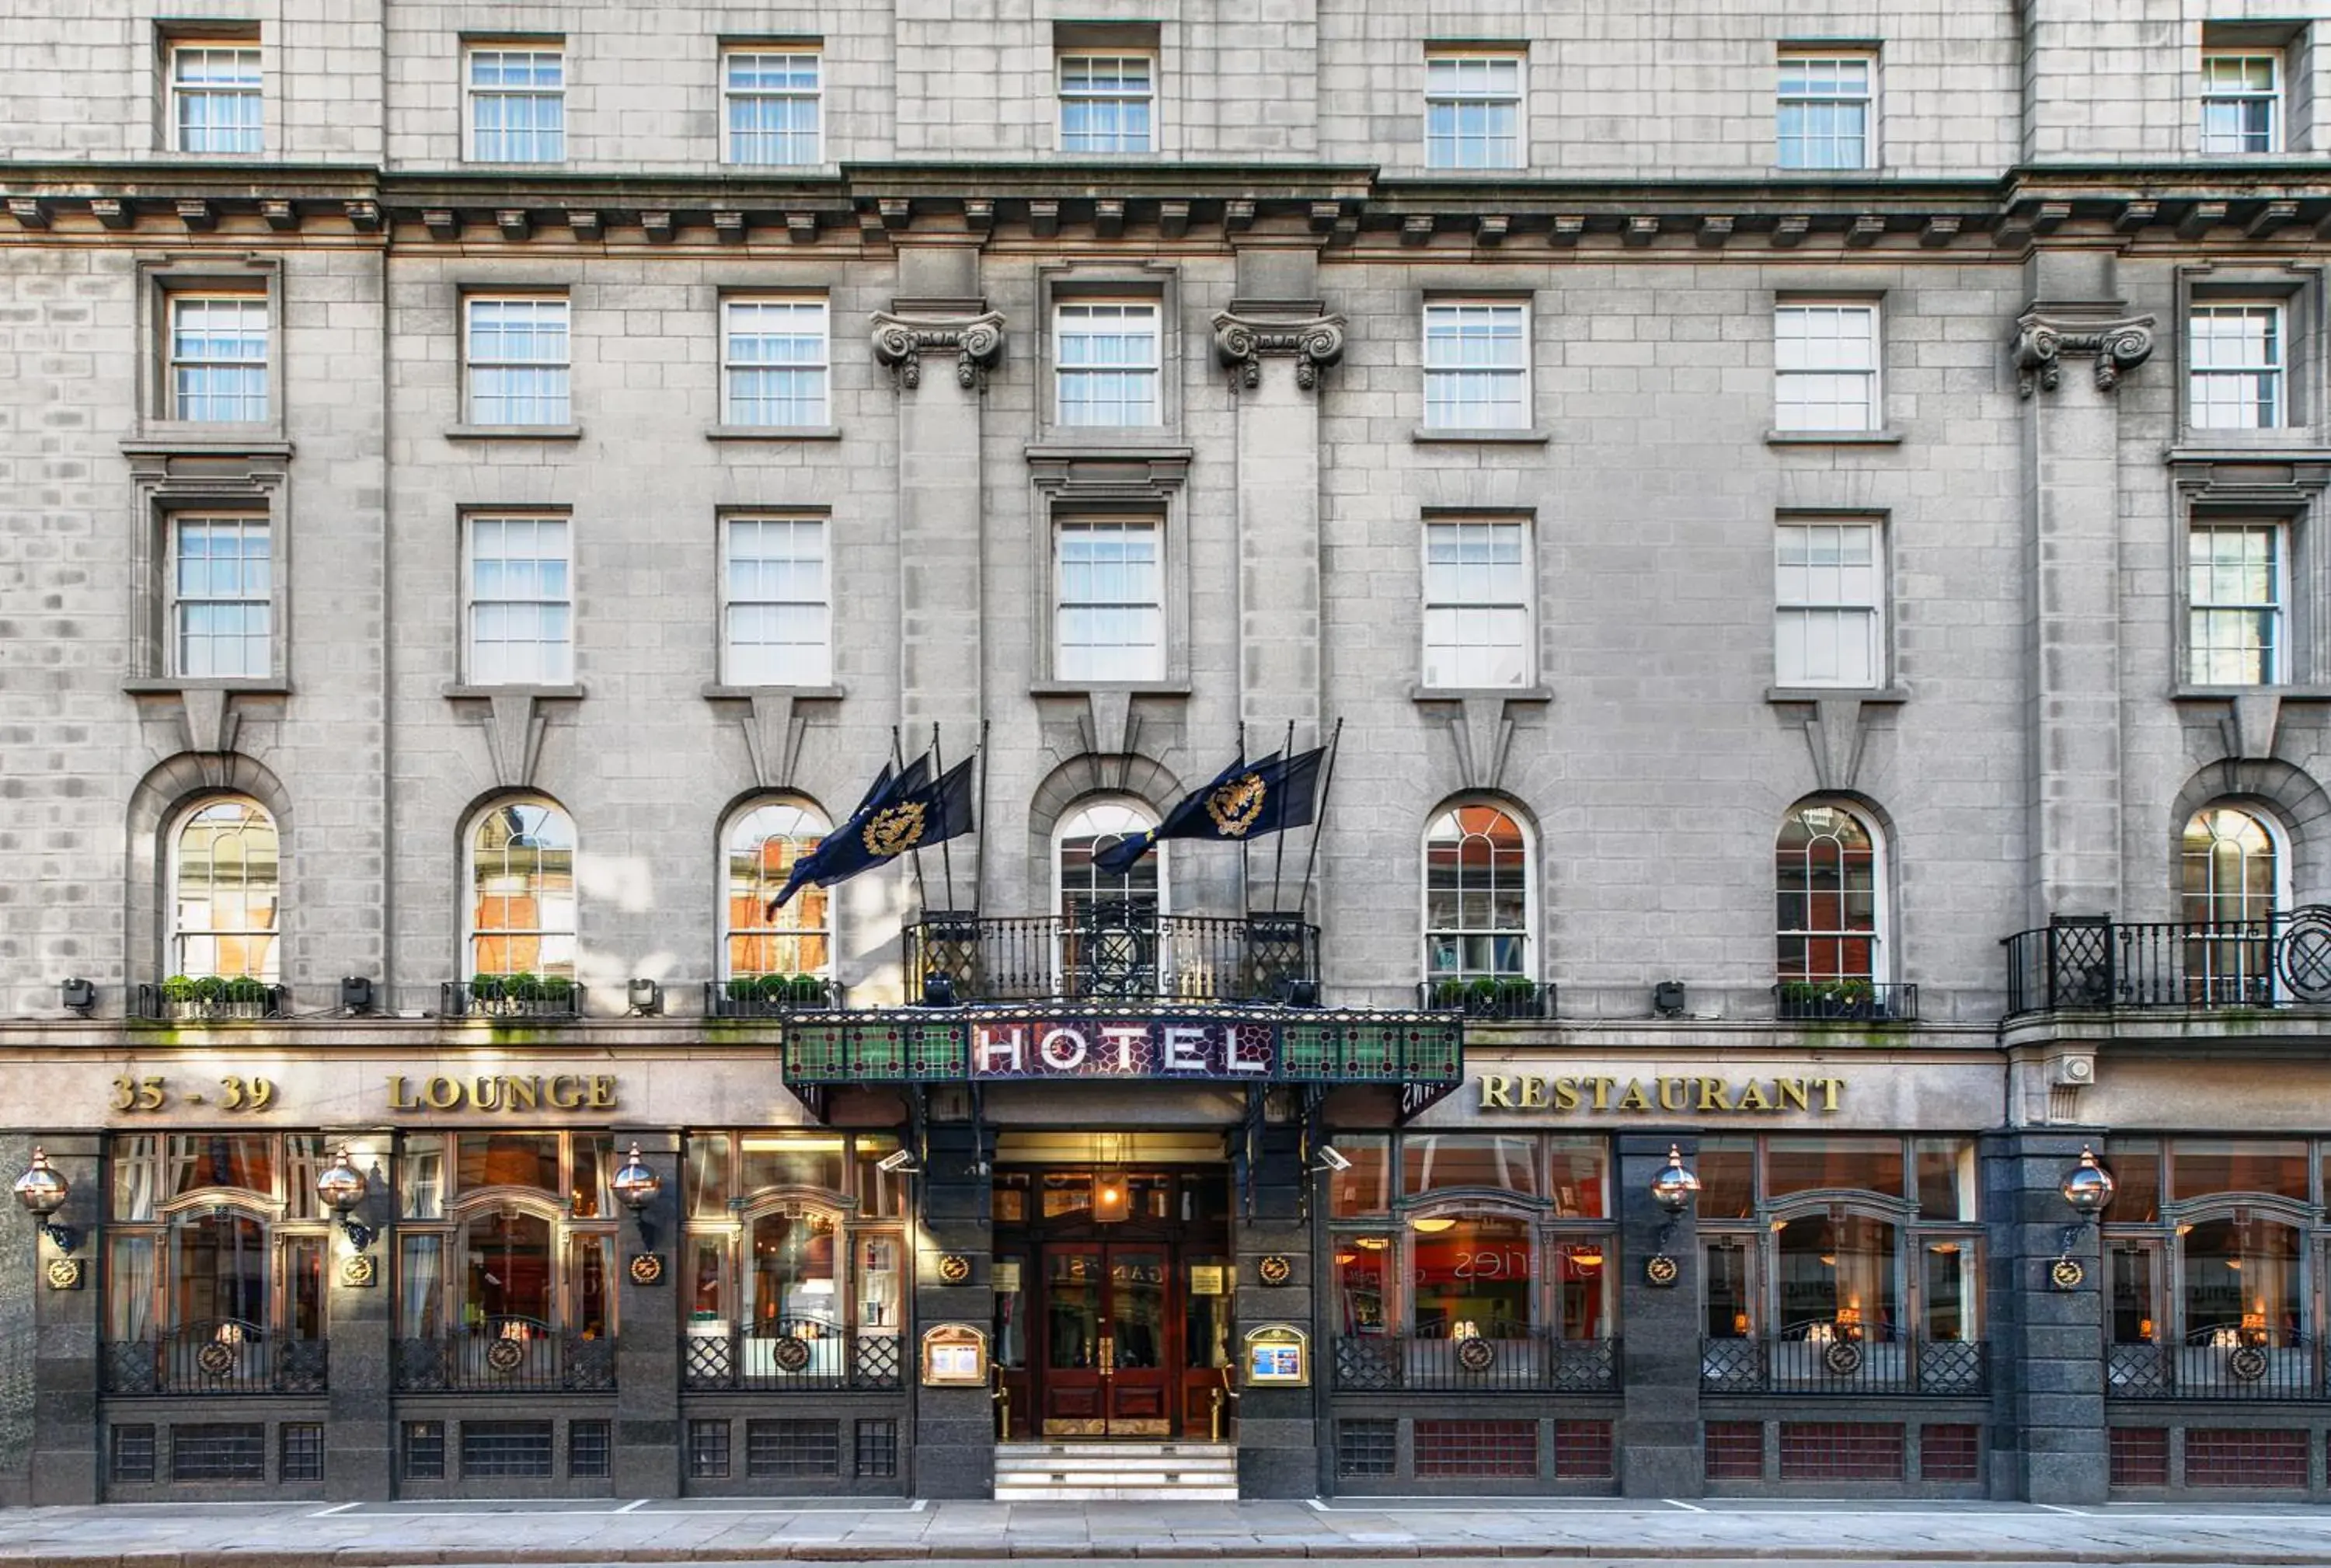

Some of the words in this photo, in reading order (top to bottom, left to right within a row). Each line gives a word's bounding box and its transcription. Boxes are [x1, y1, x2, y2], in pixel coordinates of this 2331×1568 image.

[979, 1027, 1266, 1071] HOTEL
[110, 1075, 165, 1110] 35
[217, 1075, 271, 1112] 39
[385, 1074, 618, 1110] LOUNGE
[1477, 1074, 1848, 1112] RESTAURANT
